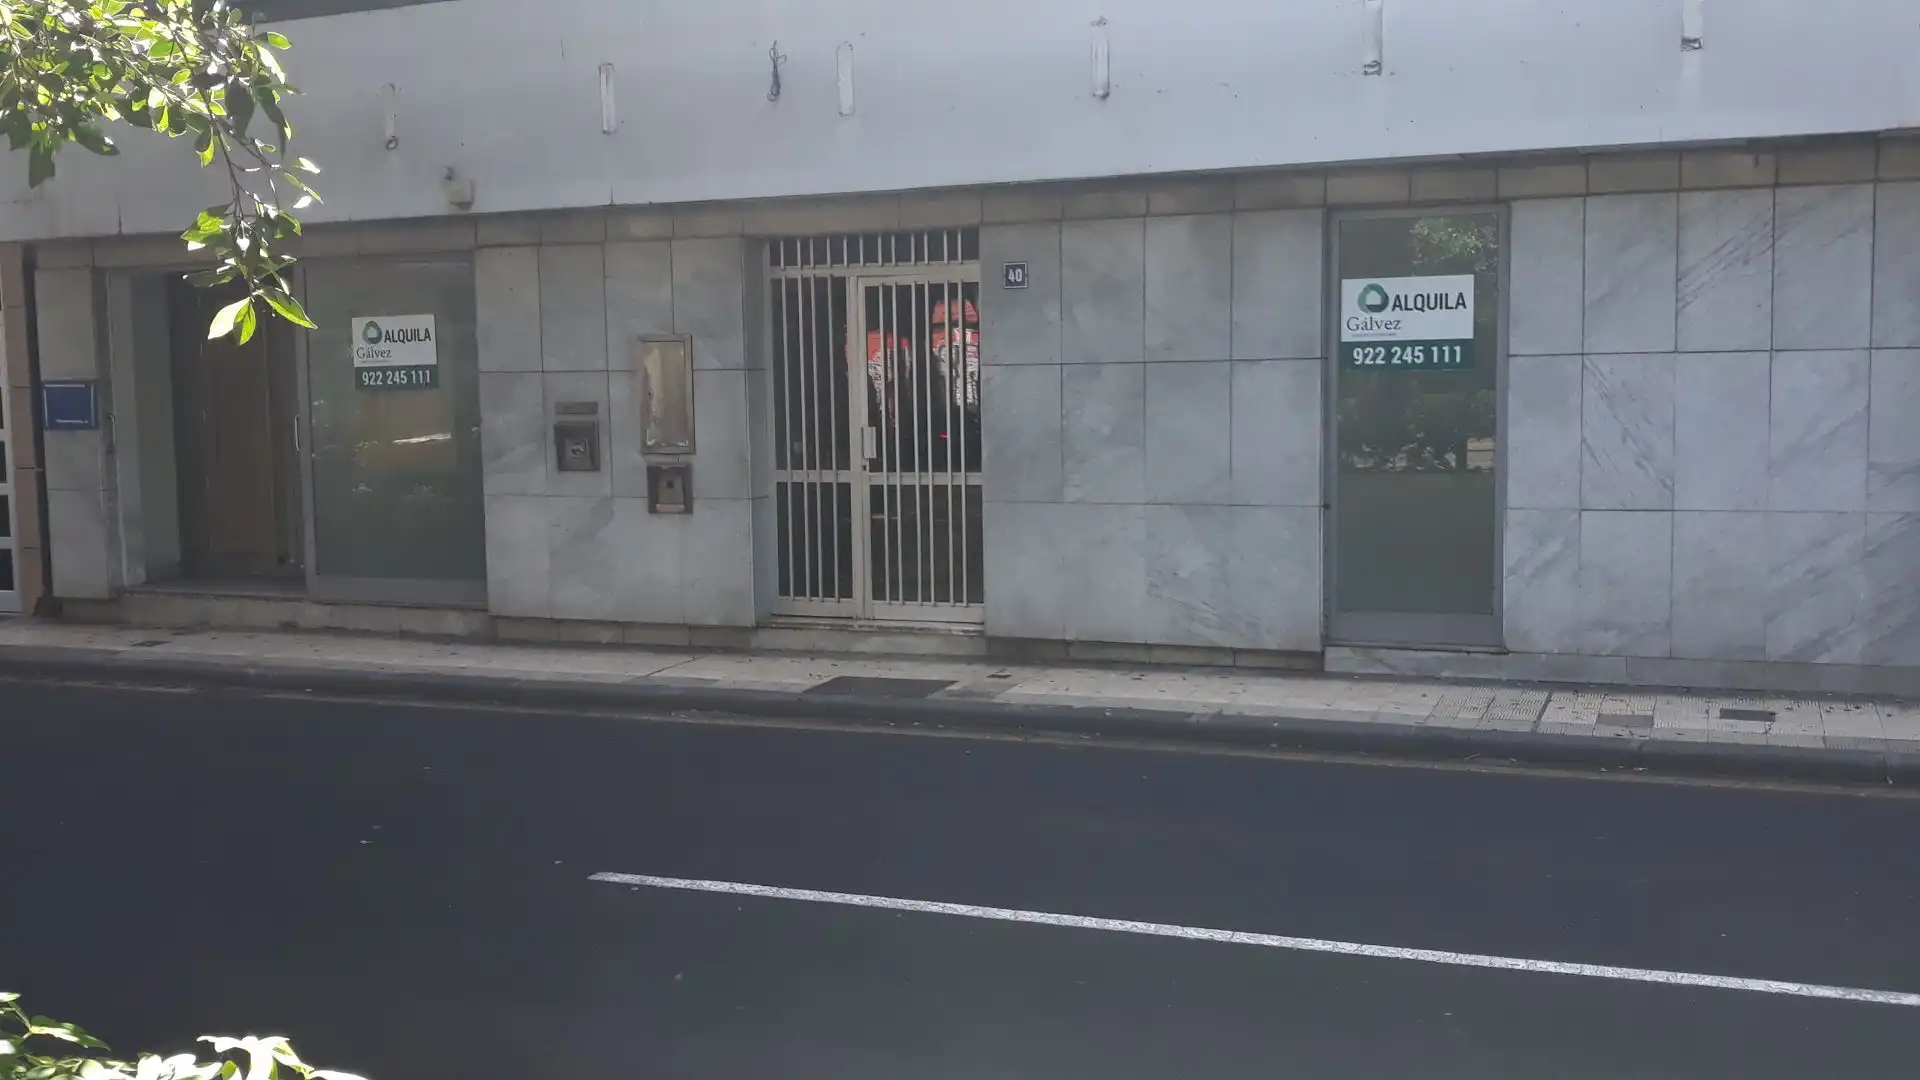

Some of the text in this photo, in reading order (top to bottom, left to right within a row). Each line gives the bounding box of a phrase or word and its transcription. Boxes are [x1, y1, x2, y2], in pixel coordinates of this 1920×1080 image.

[1008, 268, 1023, 282] 40
[1391, 292, 1467, 313] ALQUILA
[1346, 316, 1402, 332] Gálvez
[383, 327, 432, 344] ALQUILA
[356, 345, 392, 359] Gálvez
[1352, 345, 1462, 365] 922 245 111
[362, 369, 431, 386] 922 245 111
